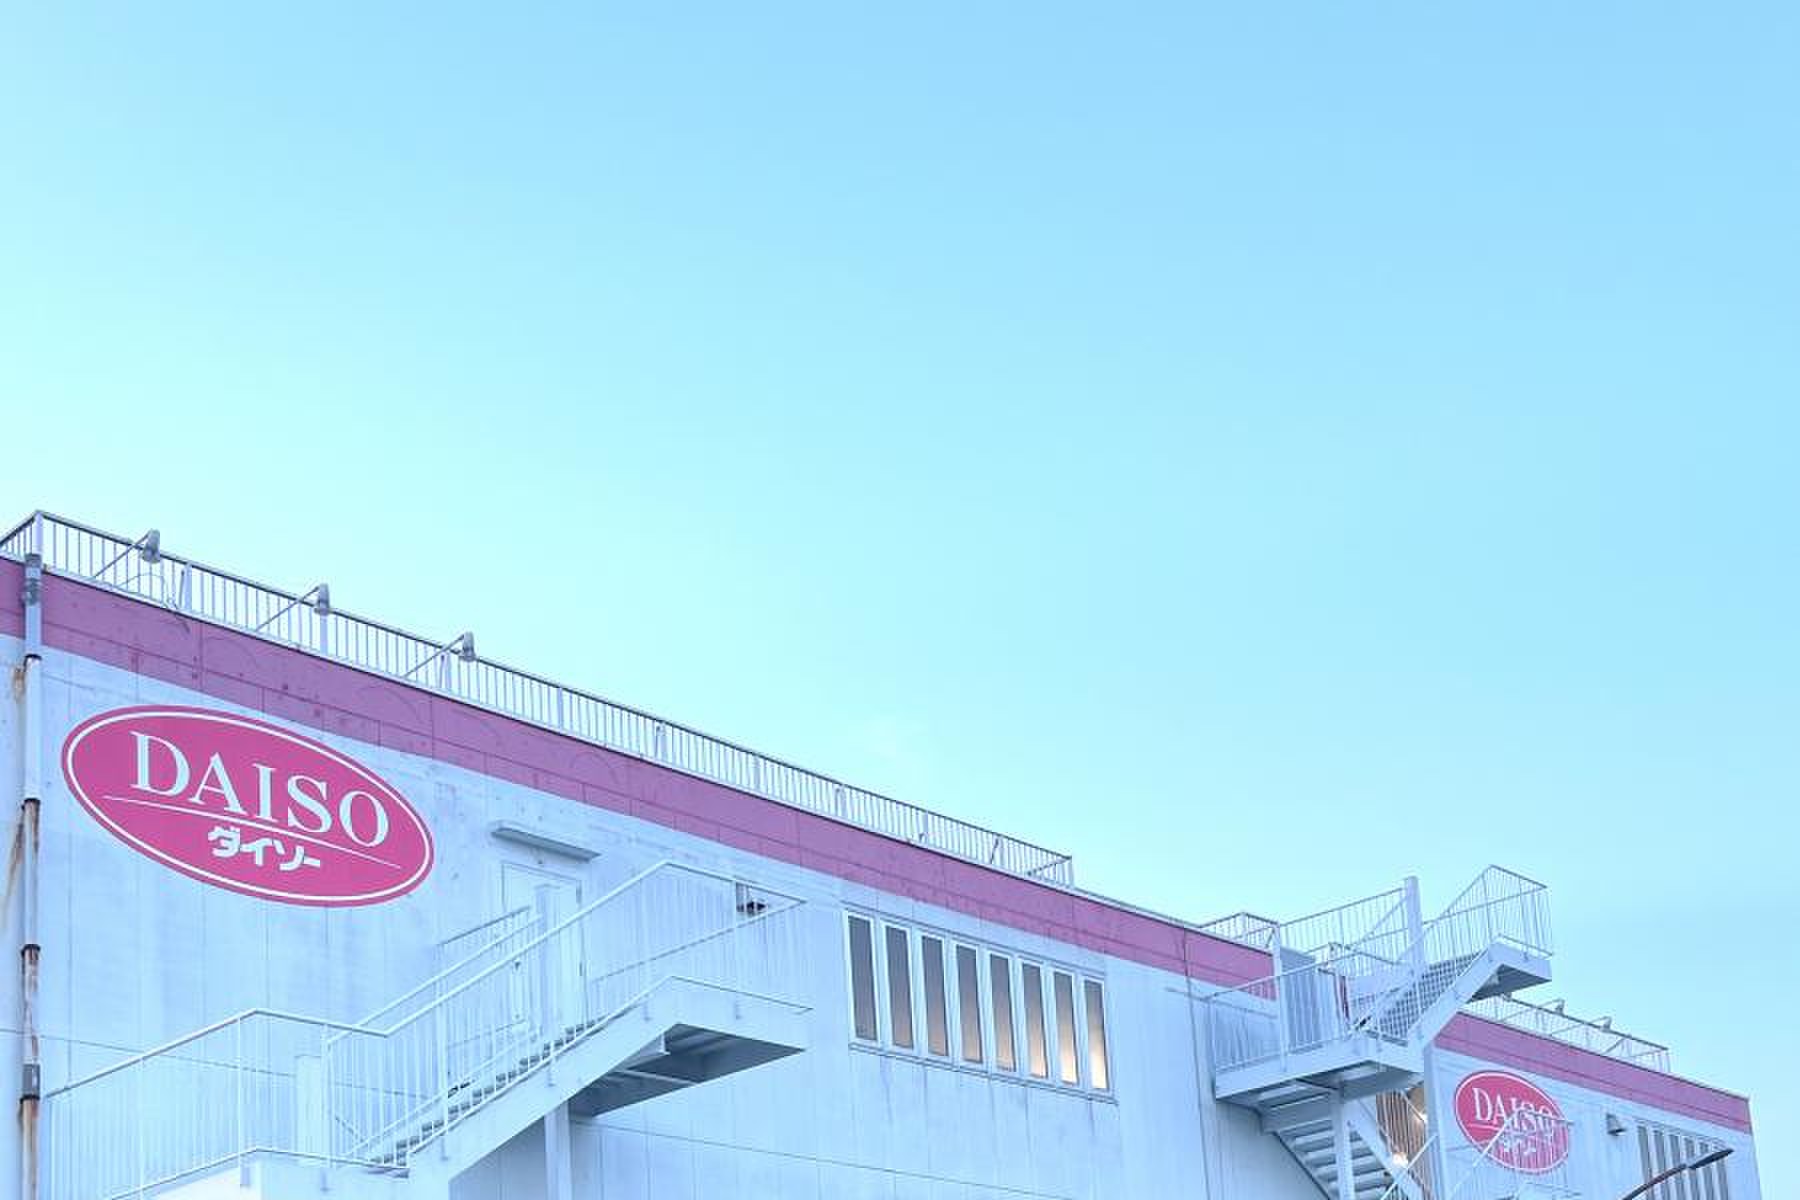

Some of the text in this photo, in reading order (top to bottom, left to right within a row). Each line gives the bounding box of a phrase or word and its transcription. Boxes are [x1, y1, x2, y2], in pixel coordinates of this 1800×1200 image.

[130, 731, 389, 848] DAISO
[207, 826, 321, 872] ダイソー
